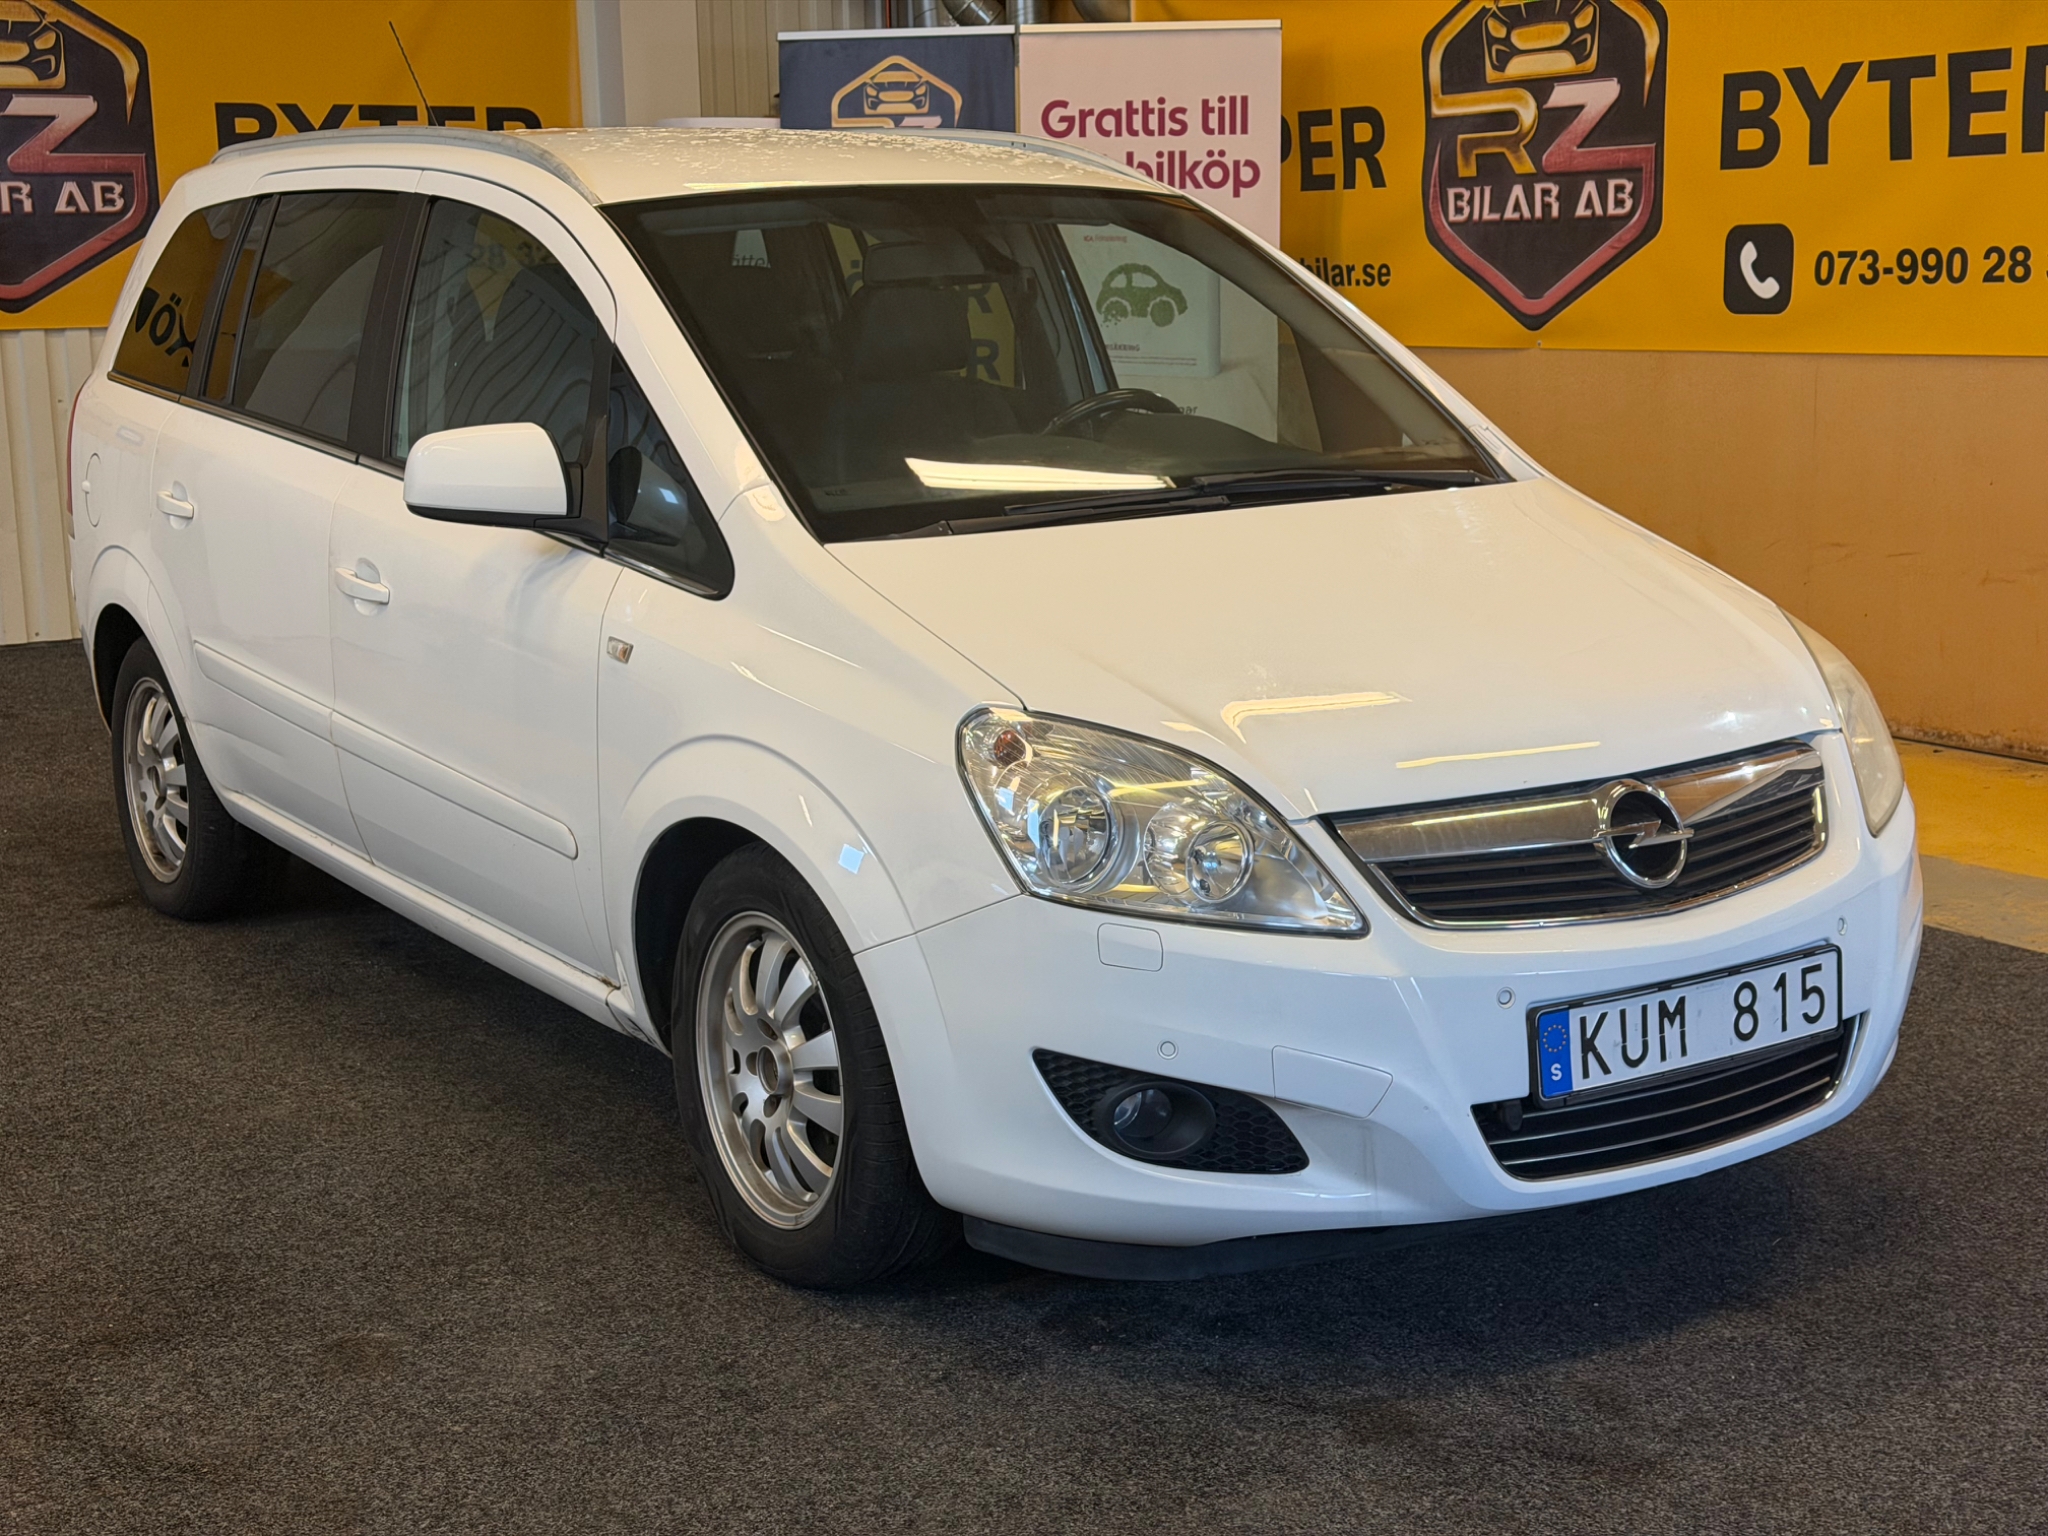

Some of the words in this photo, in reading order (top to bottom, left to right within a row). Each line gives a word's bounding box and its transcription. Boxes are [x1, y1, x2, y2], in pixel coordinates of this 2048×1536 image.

[1041, 97, 1189, 139] Grattis
[1201, 95, 1249, 136] till
[1431, 77, 1656, 178] RZ
[54, 181, 125, 214] AB
[1447, 182, 1560, 223] BILAR
[1574, 178, 1634, 218] AB
[1814, 247, 1970, 287] 073-990
[1982, 245, 2033, 284] 28
[1580, 995, 1689, 1081] KUM
[1733, 963, 1826, 1043] 815
[1550, 1062, 1563, 1082] S
